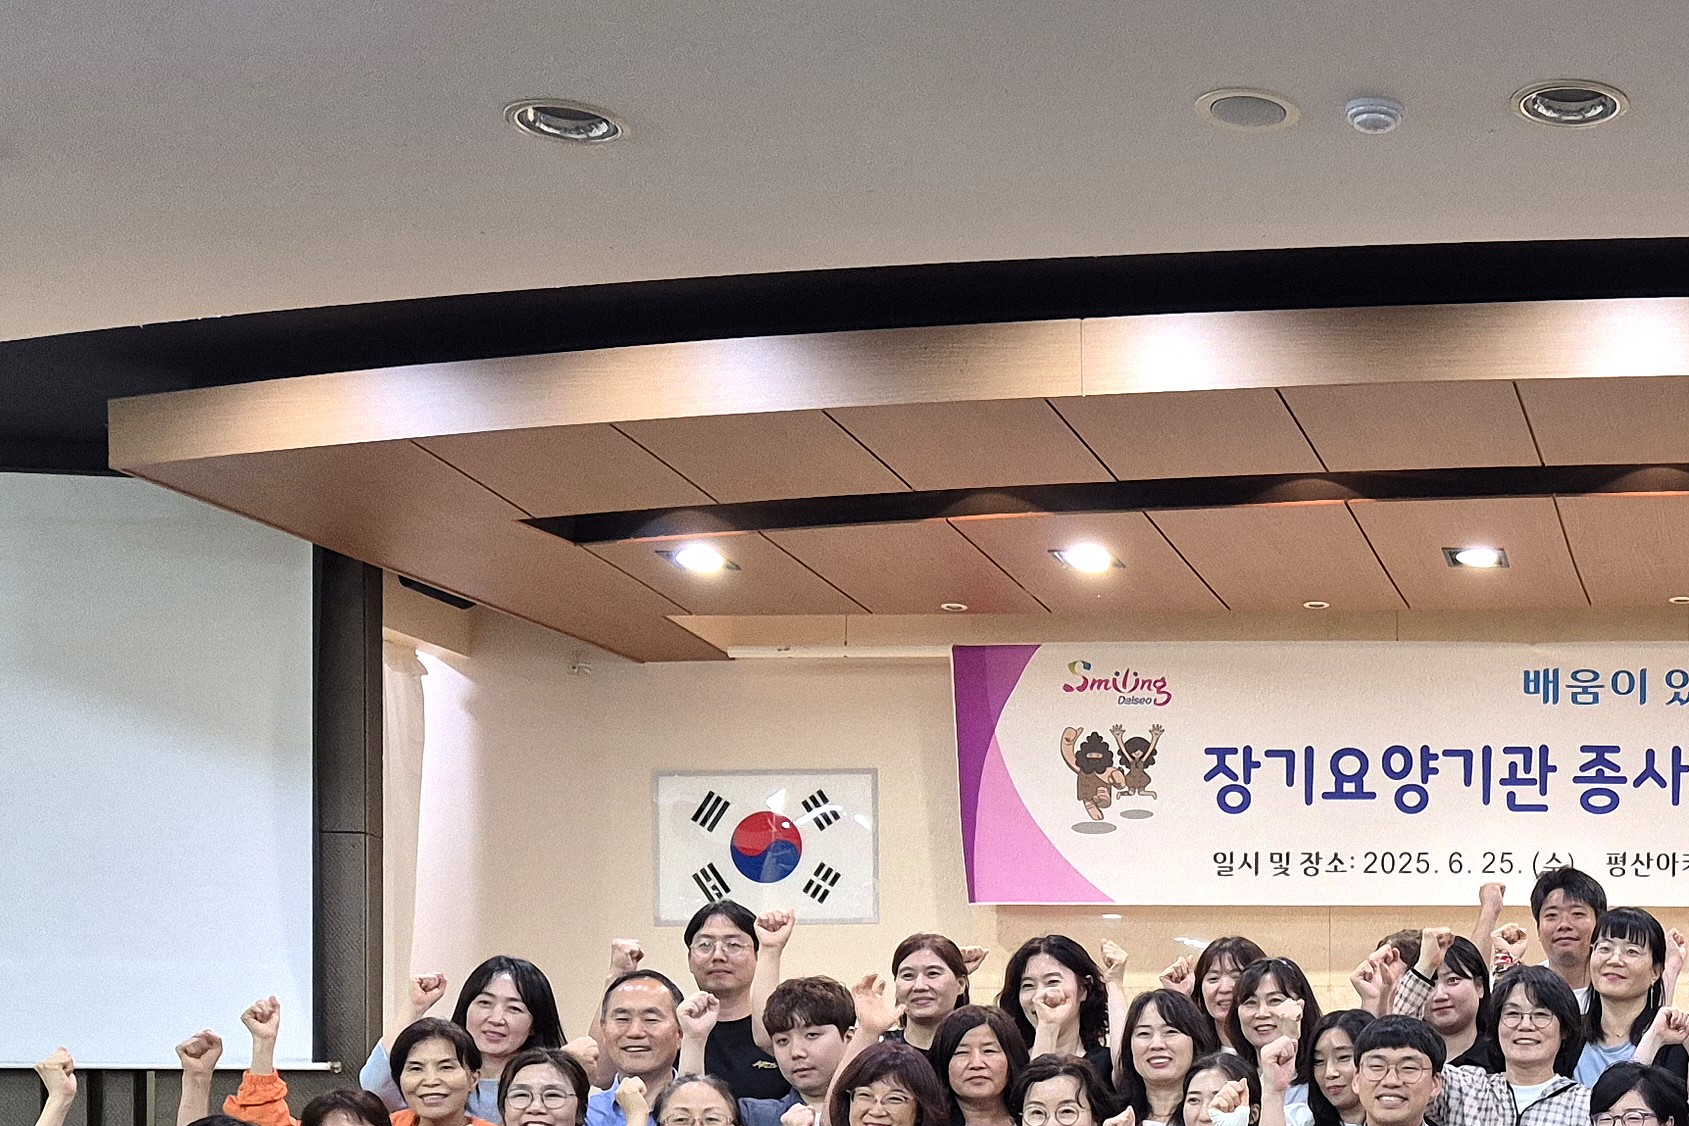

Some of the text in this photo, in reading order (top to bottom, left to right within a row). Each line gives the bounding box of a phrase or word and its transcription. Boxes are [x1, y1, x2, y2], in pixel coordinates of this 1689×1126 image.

[1062, 660, 1172, 706] Smiling
[1522, 666, 1649, 706] 배움이
[1203, 744, 1558, 815] 장기요양기관
[1213, 851, 1259, 877] 일시
[1269, 851, 1291, 877] 및
[1299, 851, 1355, 877] 장소:
[1363, 851, 1439, 875] 2025.
[1448, 851, 1472, 875] 6.
[1481, 851, 1522, 875] 25.
